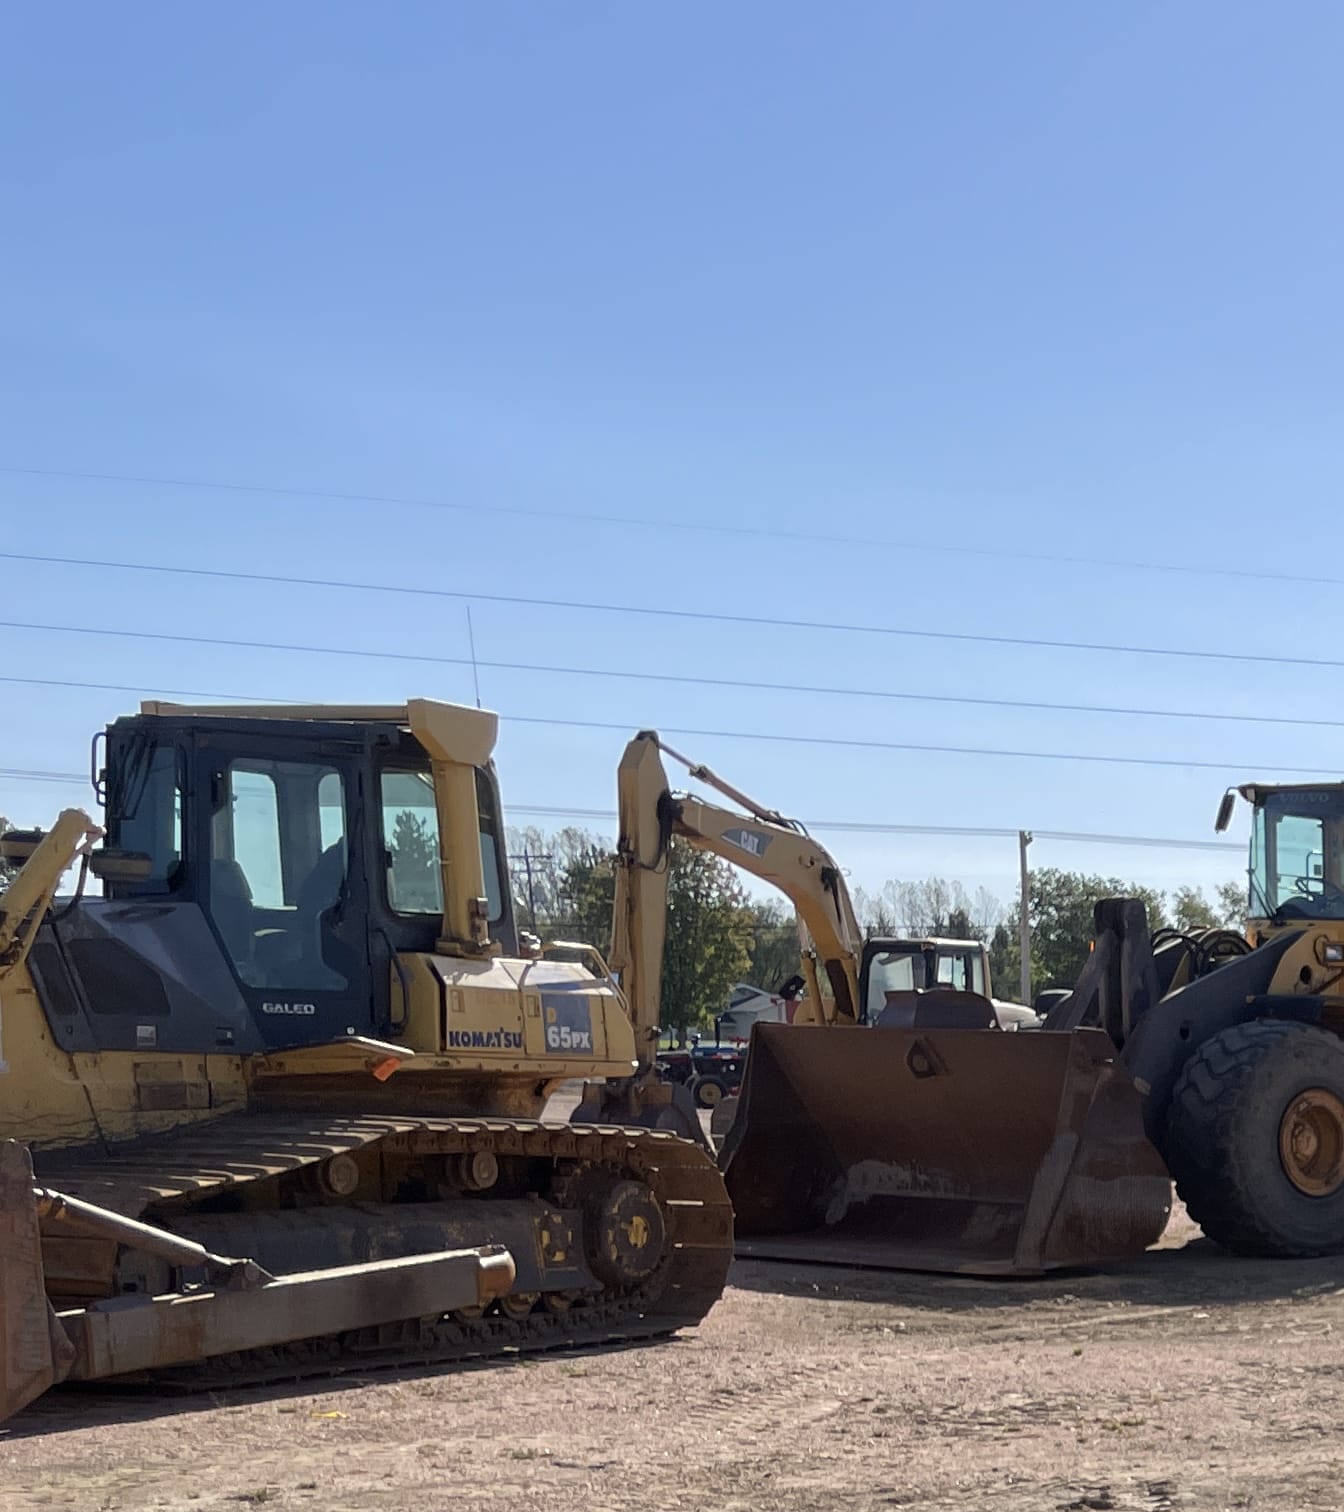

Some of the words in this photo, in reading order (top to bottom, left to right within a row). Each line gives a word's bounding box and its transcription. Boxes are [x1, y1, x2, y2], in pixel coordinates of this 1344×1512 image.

[740, 830, 759, 854] CAT
[262, 1002, 315, 1015] GALEO
[546, 1007, 556, 1023] D
[448, 1027, 523, 1049] KOMATSU
[547, 1025, 592, 1049] 65PX
